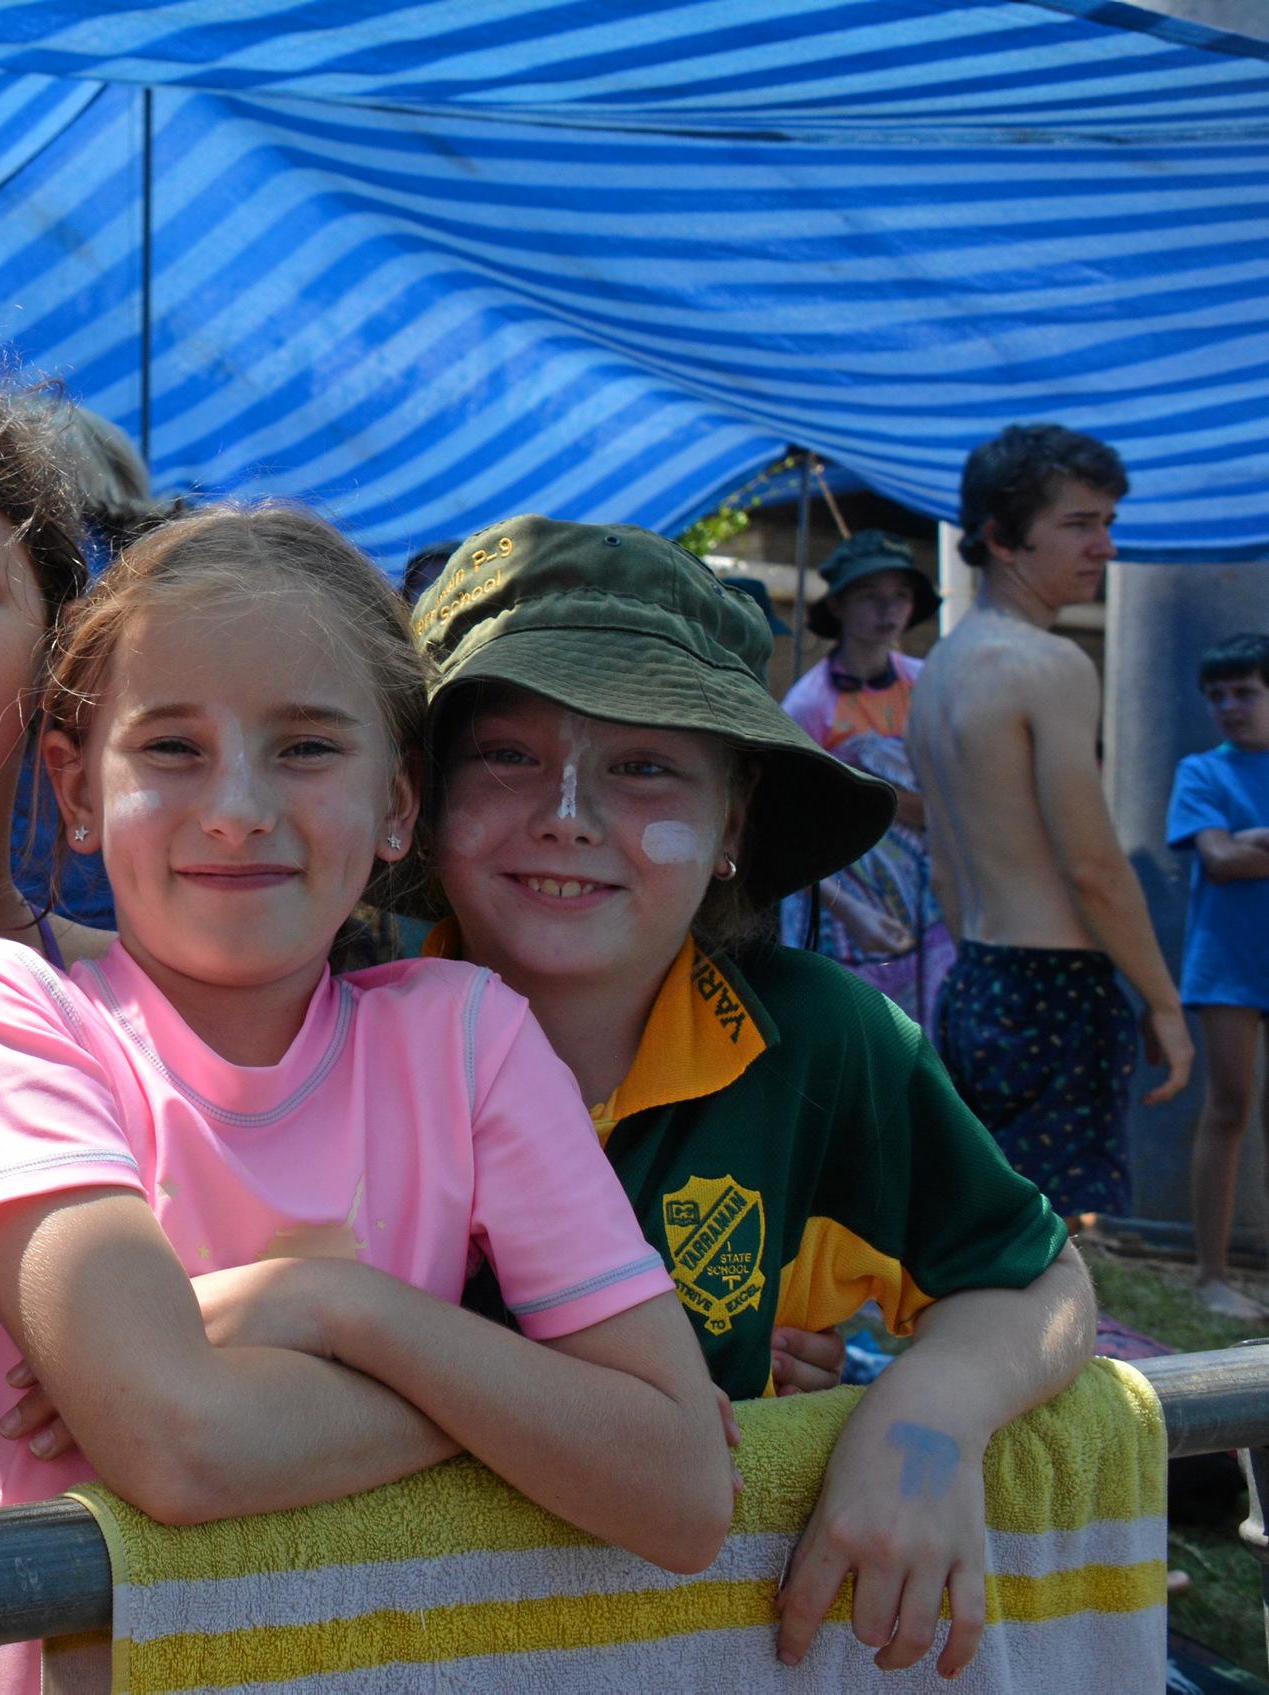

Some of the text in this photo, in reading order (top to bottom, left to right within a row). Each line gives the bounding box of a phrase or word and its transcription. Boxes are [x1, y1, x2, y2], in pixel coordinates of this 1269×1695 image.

[472, 537, 513, 573] P-9
[679, 1189, 749, 1272] YARRAMAN
[706, 1264, 750, 1276] SCHOOL
[719, 1252, 752, 1264] STATE
[710, 1320, 726, 1331] TO
[725, 1284, 762, 1312] EXCEL
